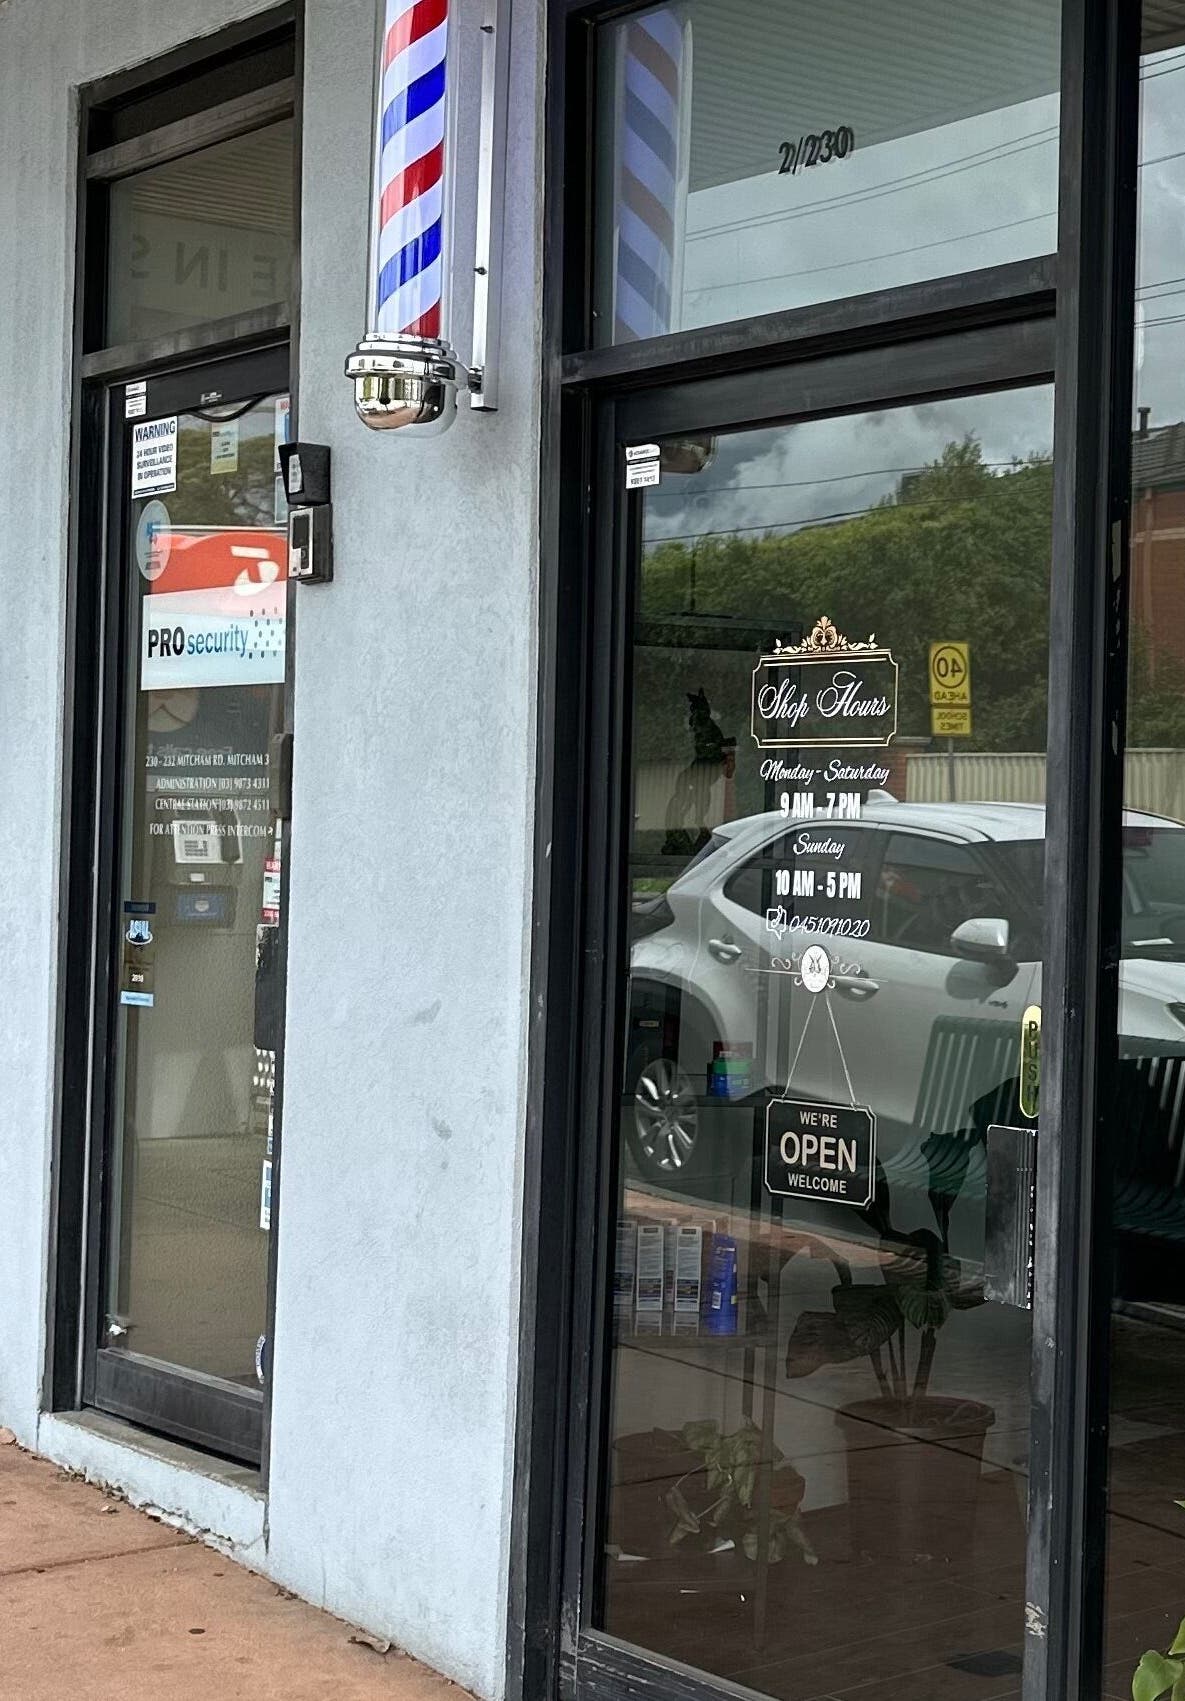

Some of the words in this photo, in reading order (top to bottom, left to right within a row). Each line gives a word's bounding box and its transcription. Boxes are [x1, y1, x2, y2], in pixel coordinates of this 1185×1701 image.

[778, 125, 854, 176] 2/230
[135, 420, 176, 443] WARNING
[143, 446, 157, 457] HOUR
[159, 443, 174, 453] VIDEO
[136, 455, 173, 470] SURVEILLANCE
[143, 467, 172, 480] OPERATION
[757, 678, 810, 728] Shop
[816, 671, 891, 718] Hours
[176, 754, 211, 767] MITCHAM
[227, 754, 263, 766] MITCHAM
[156, 777, 216, 790] ADMINISTRATION
[155, 797, 184, 811] CENTRAL
[186, 798, 218, 811] STATION
[780, 792, 790, 819] 9
[791, 792, 814, 819] AM
[826, 792, 836, 819] 7
[838, 792, 861, 819] PM
[149, 823, 164, 835] FOR
[164, 823, 205, 836] ATTENTION
[206, 824, 225, 837] PRESS
[227, 824, 267, 838] INTERCOM
[793, 833, 846, 860] Sunday
[775, 869, 790, 896] 10
[792, 870, 815, 897] AM
[826, 872, 836, 898] 5
[839, 872, 861, 899] PM
[789, 915, 870, 938] 0451091020
[799, 1110, 838, 1129] WE'RE
[780, 1131, 857, 1173] OPEN
[787, 1172, 847, 1194] WELCOME
